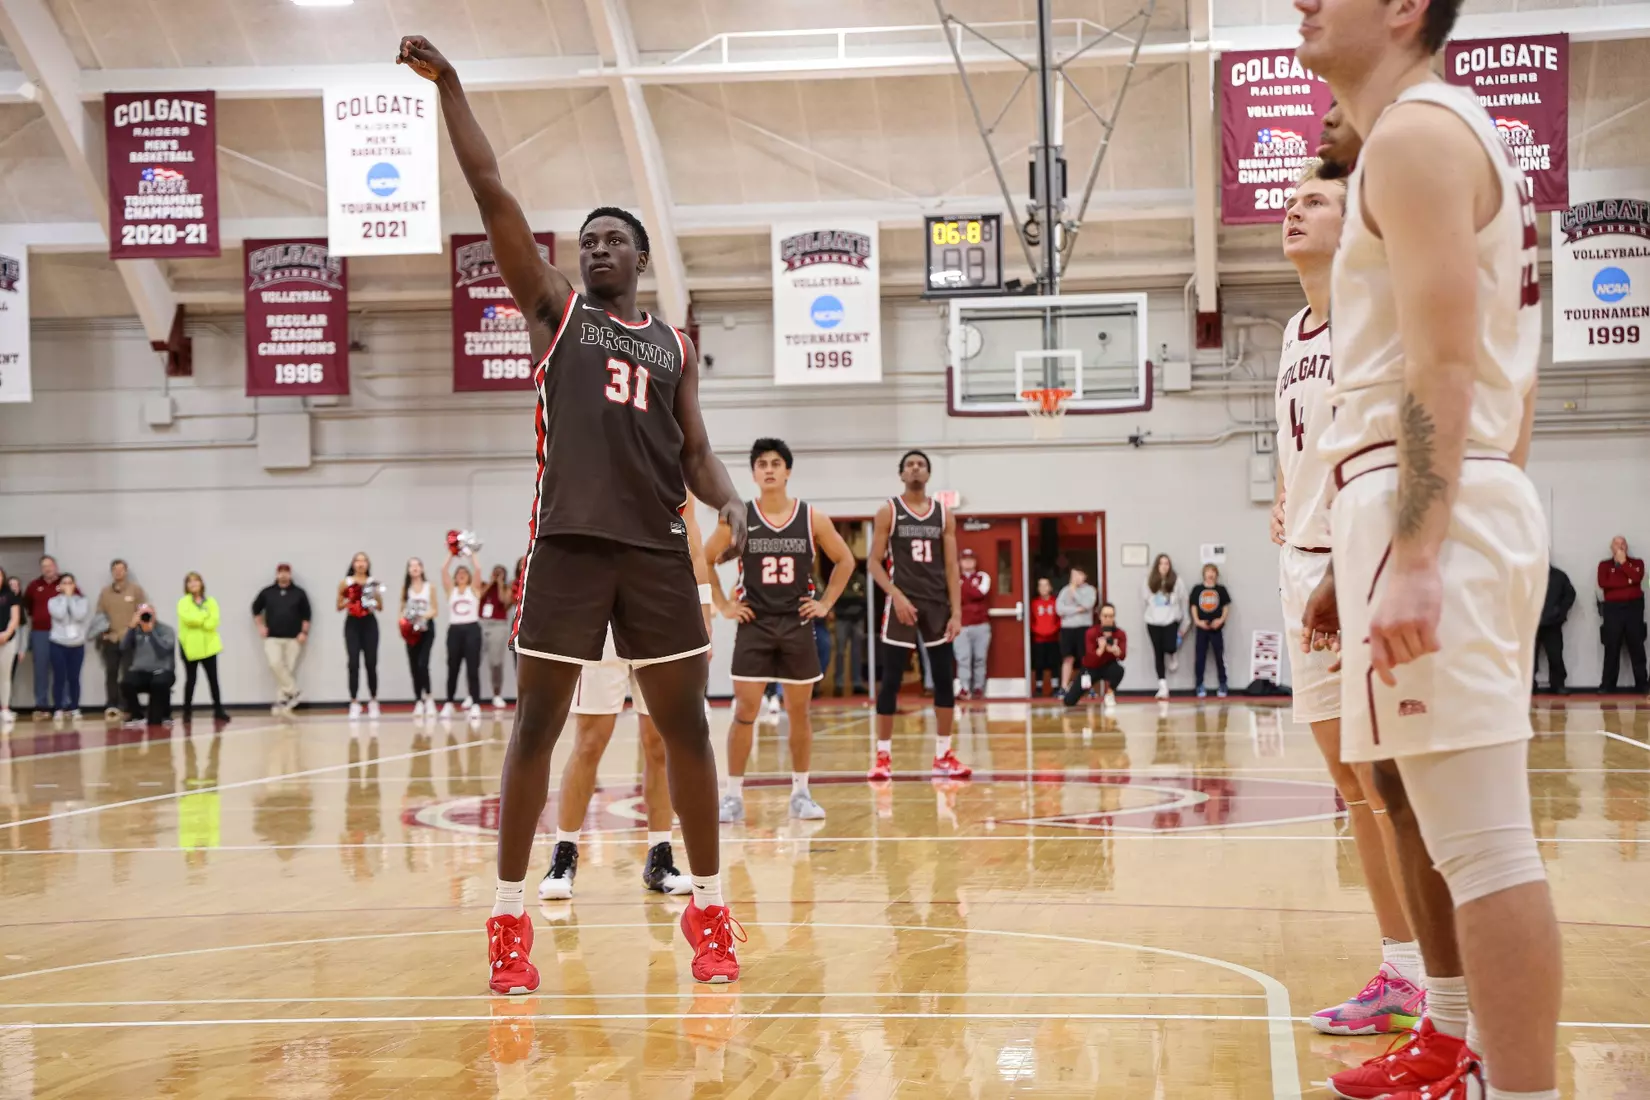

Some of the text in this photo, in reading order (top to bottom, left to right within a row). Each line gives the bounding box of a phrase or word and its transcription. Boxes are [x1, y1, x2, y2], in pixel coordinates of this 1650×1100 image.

[1455, 43, 1558, 76] COLGATE
[1231, 55, 1328, 87] COLGA
[1475, 72, 1538, 86] RAIDERS
[1250, 84, 1311, 96] RAIDERS
[114, 99, 207, 127] COLGATE
[336, 95, 424, 120] COLGATE
[1246, 104, 1315, 118] VOLLEYBALL
[132, 126, 190, 137] RAIDERS
[144, 139, 179, 151] MEN'S
[129, 151, 195, 163] BASKETBALL
[1238, 158, 1283, 169] REGULAR
[124, 194, 204, 207] TOURNAMENT
[341, 201, 426, 214] TOURNAMENT
[124, 206, 204, 220] CHAMPIONS
[121, 224, 208, 245] 2020-21
[362, 221, 407, 239] 2021
[261, 290, 332, 303] VOLLEYBALL
[266, 314, 328, 328] REGULAR
[271, 328, 323, 342] SEASON
[785, 332, 869, 345] TOURNAMENT
[1588, 325, 1640, 345] 1999
[258, 341, 336, 356] CHAMPIONS
[580, 322, 675, 373] BROWN
[806, 351, 852, 369] 1996
[275, 363, 324, 384] 1996
[482, 358, 531, 380] 1996
[604, 357, 650, 412] 31
[1289, 398, 1305, 452] 4
[747, 538, 807, 554] BROWN
[911, 539, 933, 563] 21
[761, 556, 795, 585] 23
